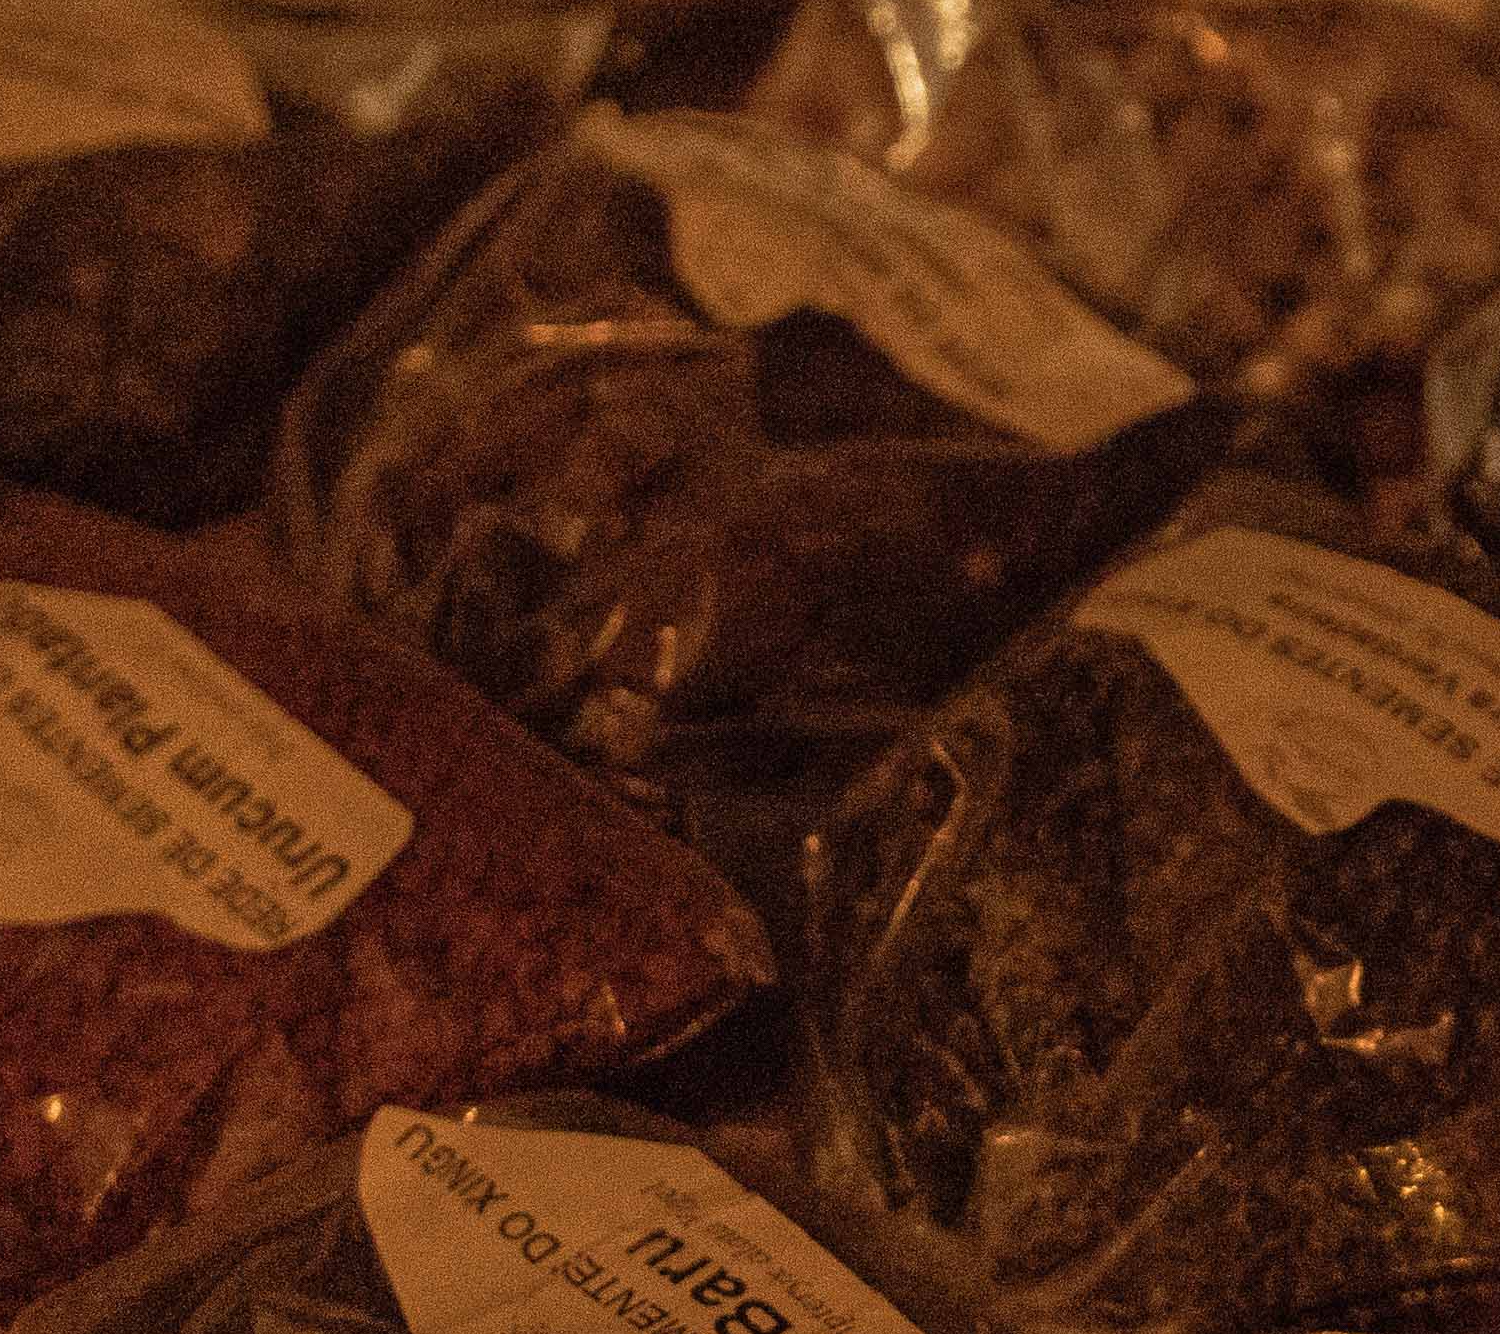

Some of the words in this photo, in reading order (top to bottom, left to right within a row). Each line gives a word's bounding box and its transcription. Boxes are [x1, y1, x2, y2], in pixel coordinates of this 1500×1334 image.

[166, 743, 352, 899] Urucum
[396, 1124, 509, 1215] XINGU
[498, 1212, 561, 1264] DO
